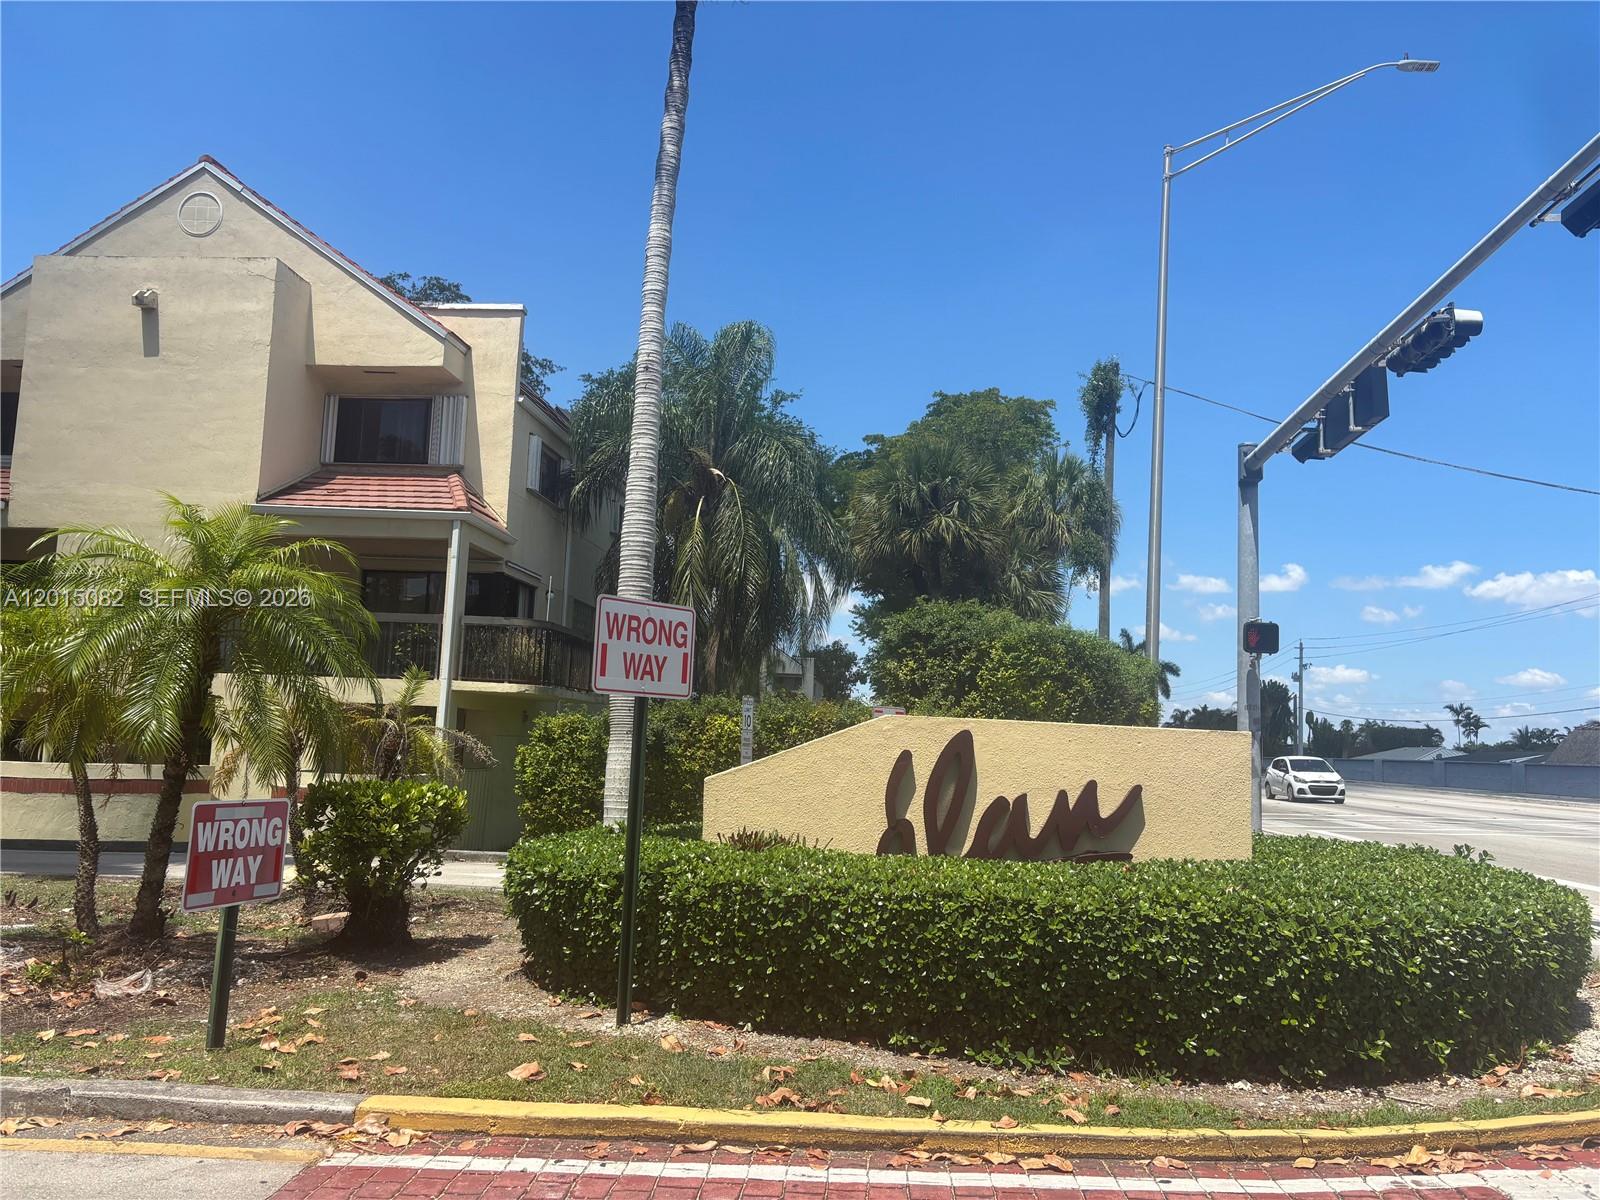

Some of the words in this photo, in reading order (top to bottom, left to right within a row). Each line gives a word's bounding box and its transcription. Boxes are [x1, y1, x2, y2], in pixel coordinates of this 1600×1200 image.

[606, 611, 688, 649] WRONG
[623, 651, 668, 682] WAY
[197, 817, 283, 853] WRONG
[211, 854, 264, 890] WAY
